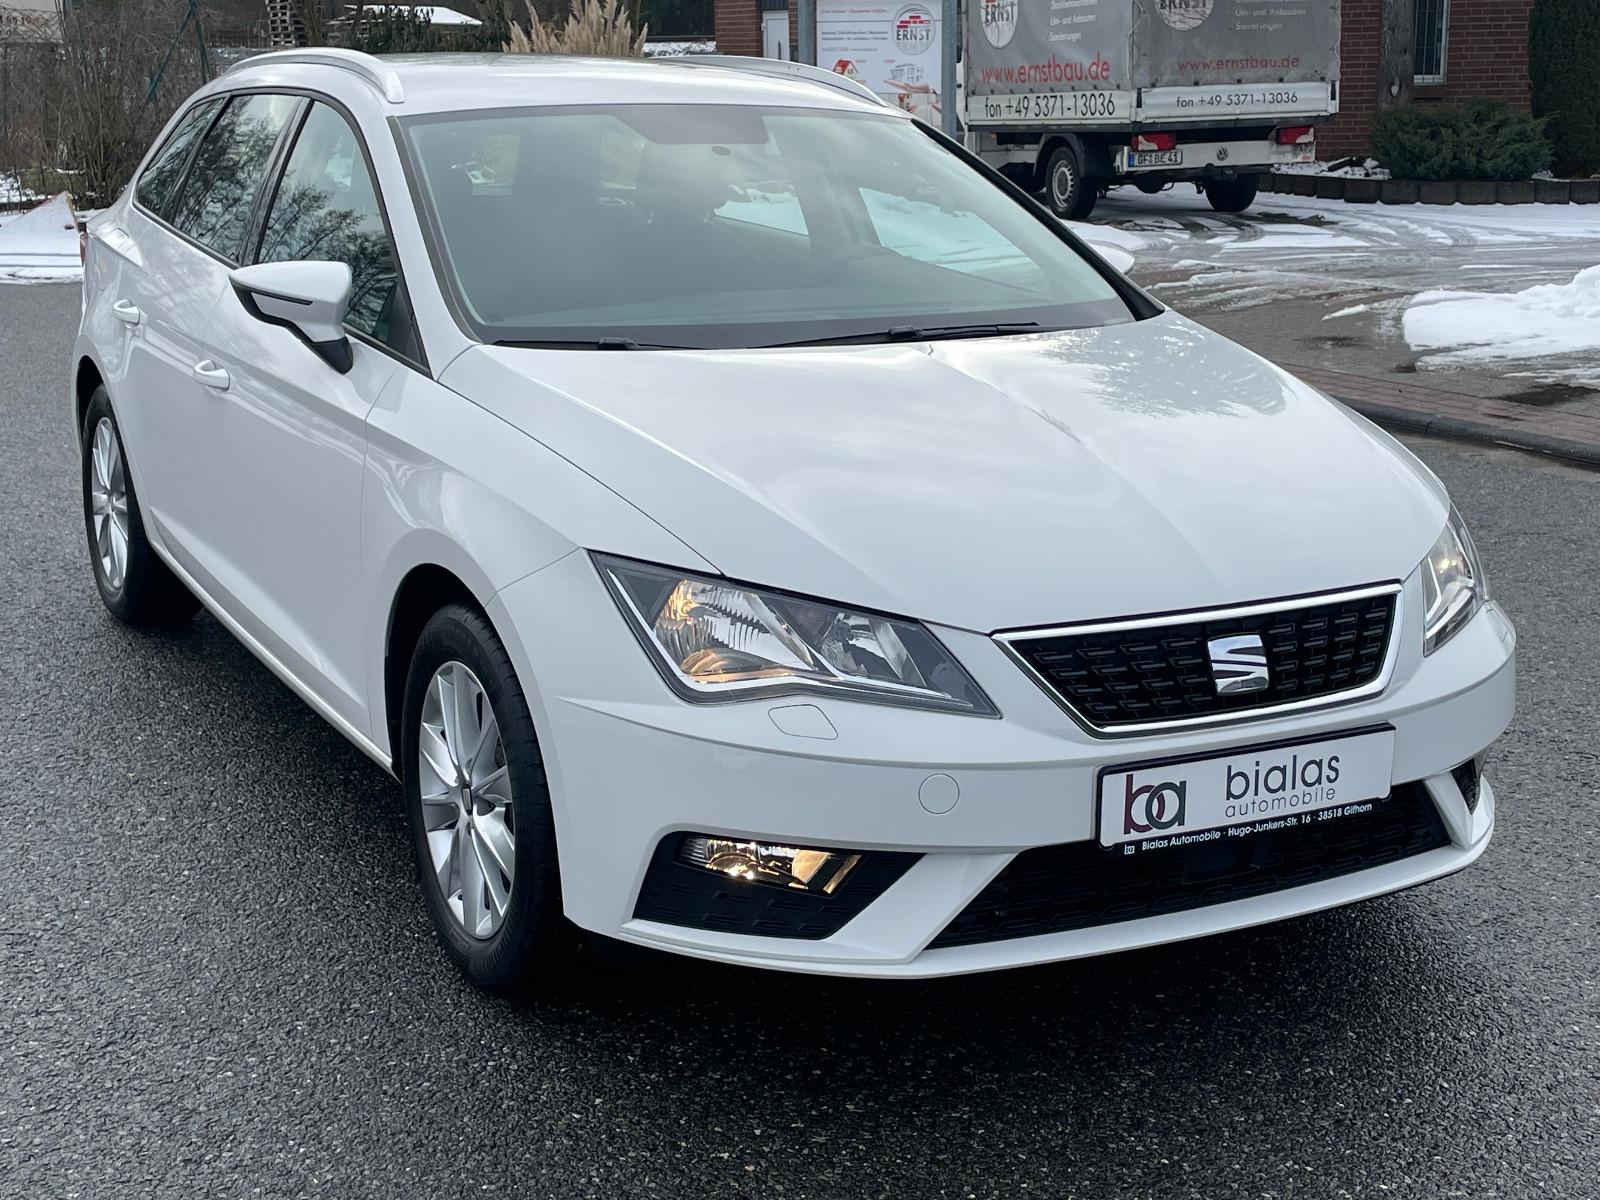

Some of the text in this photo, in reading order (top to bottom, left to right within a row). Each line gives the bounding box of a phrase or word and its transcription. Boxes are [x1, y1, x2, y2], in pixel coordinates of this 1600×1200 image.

[985, 2, 1016, 23] ERNST
[896, 29, 931, 41] ERNST
[982, 52, 1110, 83] www.ernstbau.de
[1178, 55, 1300, 72] www.ernstbau.de
[985, 92, 1115, 117] fon +49 5371-13036
[1176, 91, 1298, 108] fon +49 5371-13036
[1137, 152, 1178, 165] GF BE 41
[1225, 754, 1340, 801] bialas
[1123, 773, 1187, 835] ba
[1225, 787, 1336, 818] automobile
[1142, 840, 1168, 851] Bialas
[1169, 830, 1221, 847] Automobile
[1228, 817, 1298, 837] Hugo-Junkers-Str.
[1301, 814, 1311, 824] 16
[1318, 807, 1342, 821] 38518
[1344, 803, 1373, 815] Gifhorn
